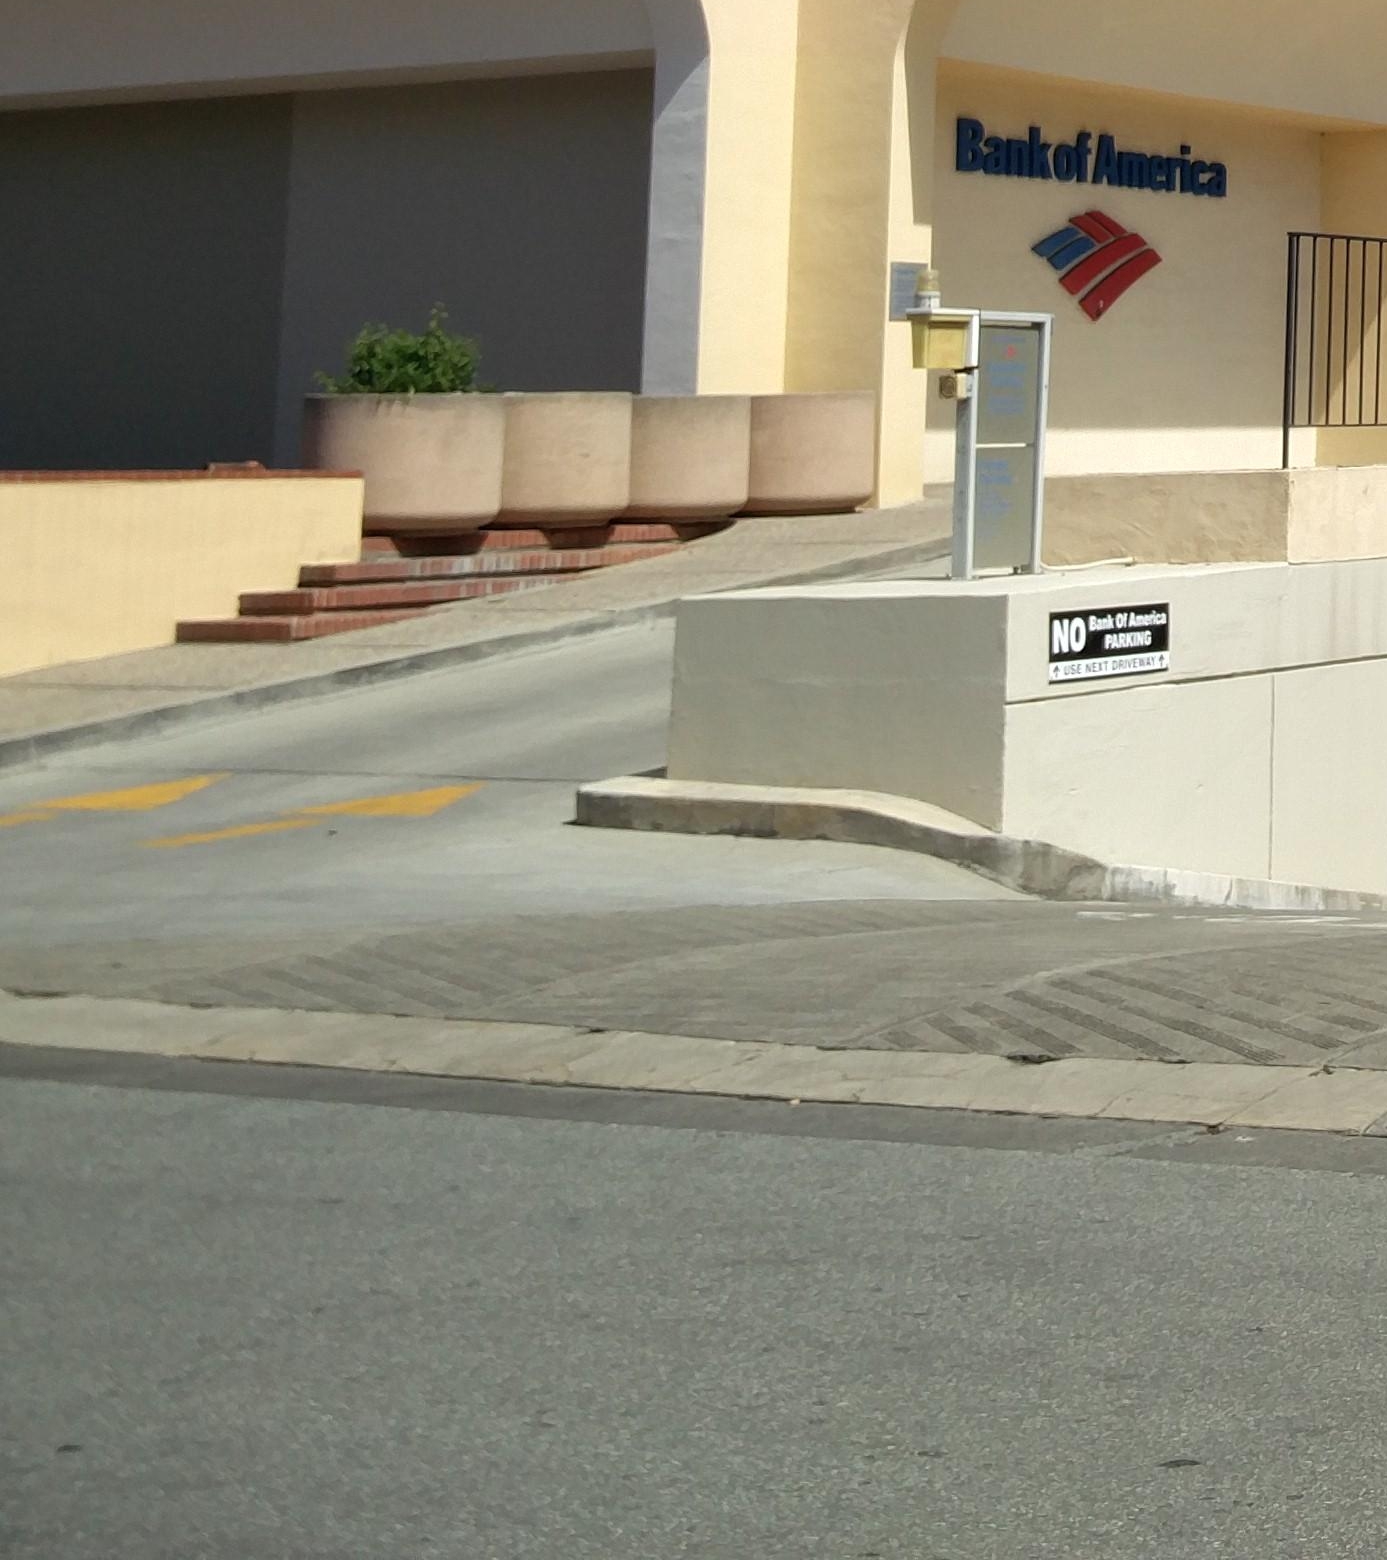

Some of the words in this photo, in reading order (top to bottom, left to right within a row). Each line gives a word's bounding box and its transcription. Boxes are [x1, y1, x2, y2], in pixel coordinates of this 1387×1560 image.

[955, 117, 1052, 180] Bank
[1053, 130, 1092, 183] of
[1091, 133, 1227, 198] America
[1088, 614, 1115, 631] Bank
[1115, 612, 1128, 629] Of
[1128, 610, 1167, 627] America
[1053, 617, 1086, 654] NO
[1104, 630, 1152, 650] PARKING
[1063, 663, 1082, 676] USE
[1085, 660, 1109, 673] NEXT
[1111, 656, 1157, 671] DRIVEWAY
